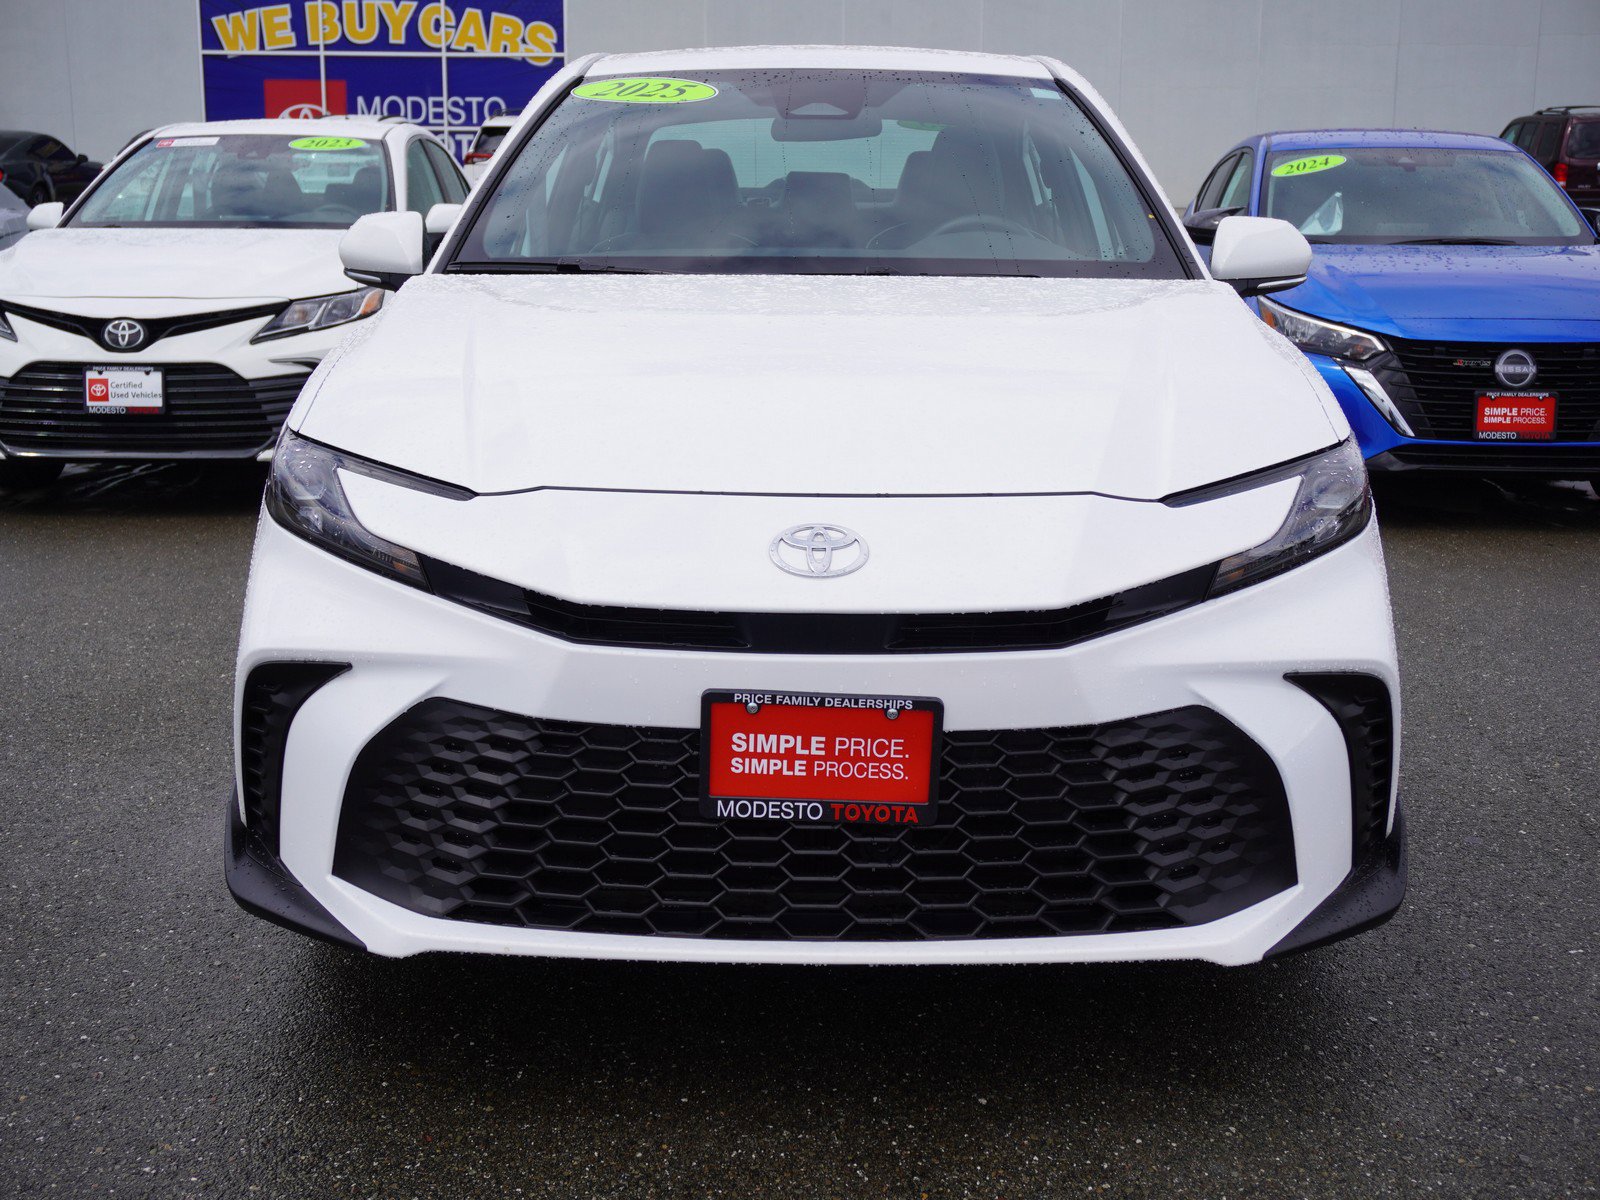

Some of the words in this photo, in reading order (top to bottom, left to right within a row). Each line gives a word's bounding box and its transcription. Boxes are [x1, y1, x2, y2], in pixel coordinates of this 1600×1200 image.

[211, 4, 297, 58] WE
[304, 0, 418, 45] BUY
[418, 2, 558, 66] CARS
[590, 82, 698, 98] 2025
[356, 95, 507, 124] MODESTO
[303, 138, 353, 149] 2023
[1284, 157, 1330, 175] 2024
[1496, 365, 1536, 373] NISSAN
[110, 381, 143, 389] Certified
[110, 391, 129, 399] Used
[131, 391, 163, 399] Vehicles
[88, 406, 127, 414] MODESTO
[1484, 407, 1518, 416] SIMPLE
[1520, 408, 1547, 417] PRICE.
[1483, 416, 1511, 424] SIMPLE
[1512, 417, 1546, 425] PROCESS.
[1478, 432, 1517, 440] MODESTO
[733, 693, 773, 705] PRICE
[776, 695, 821, 707] FAMILY
[825, 697, 913, 710] DEALERSHIPS
[731, 732, 826, 756] SIMPLE
[834, 736, 910, 759] PRICE.
[730, 757, 807, 777] SIMPLE
[813, 760, 909, 780] PROCESS.
[716, 799, 824, 820] MODESTO
[830, 803, 919, 824] TOYOTA
